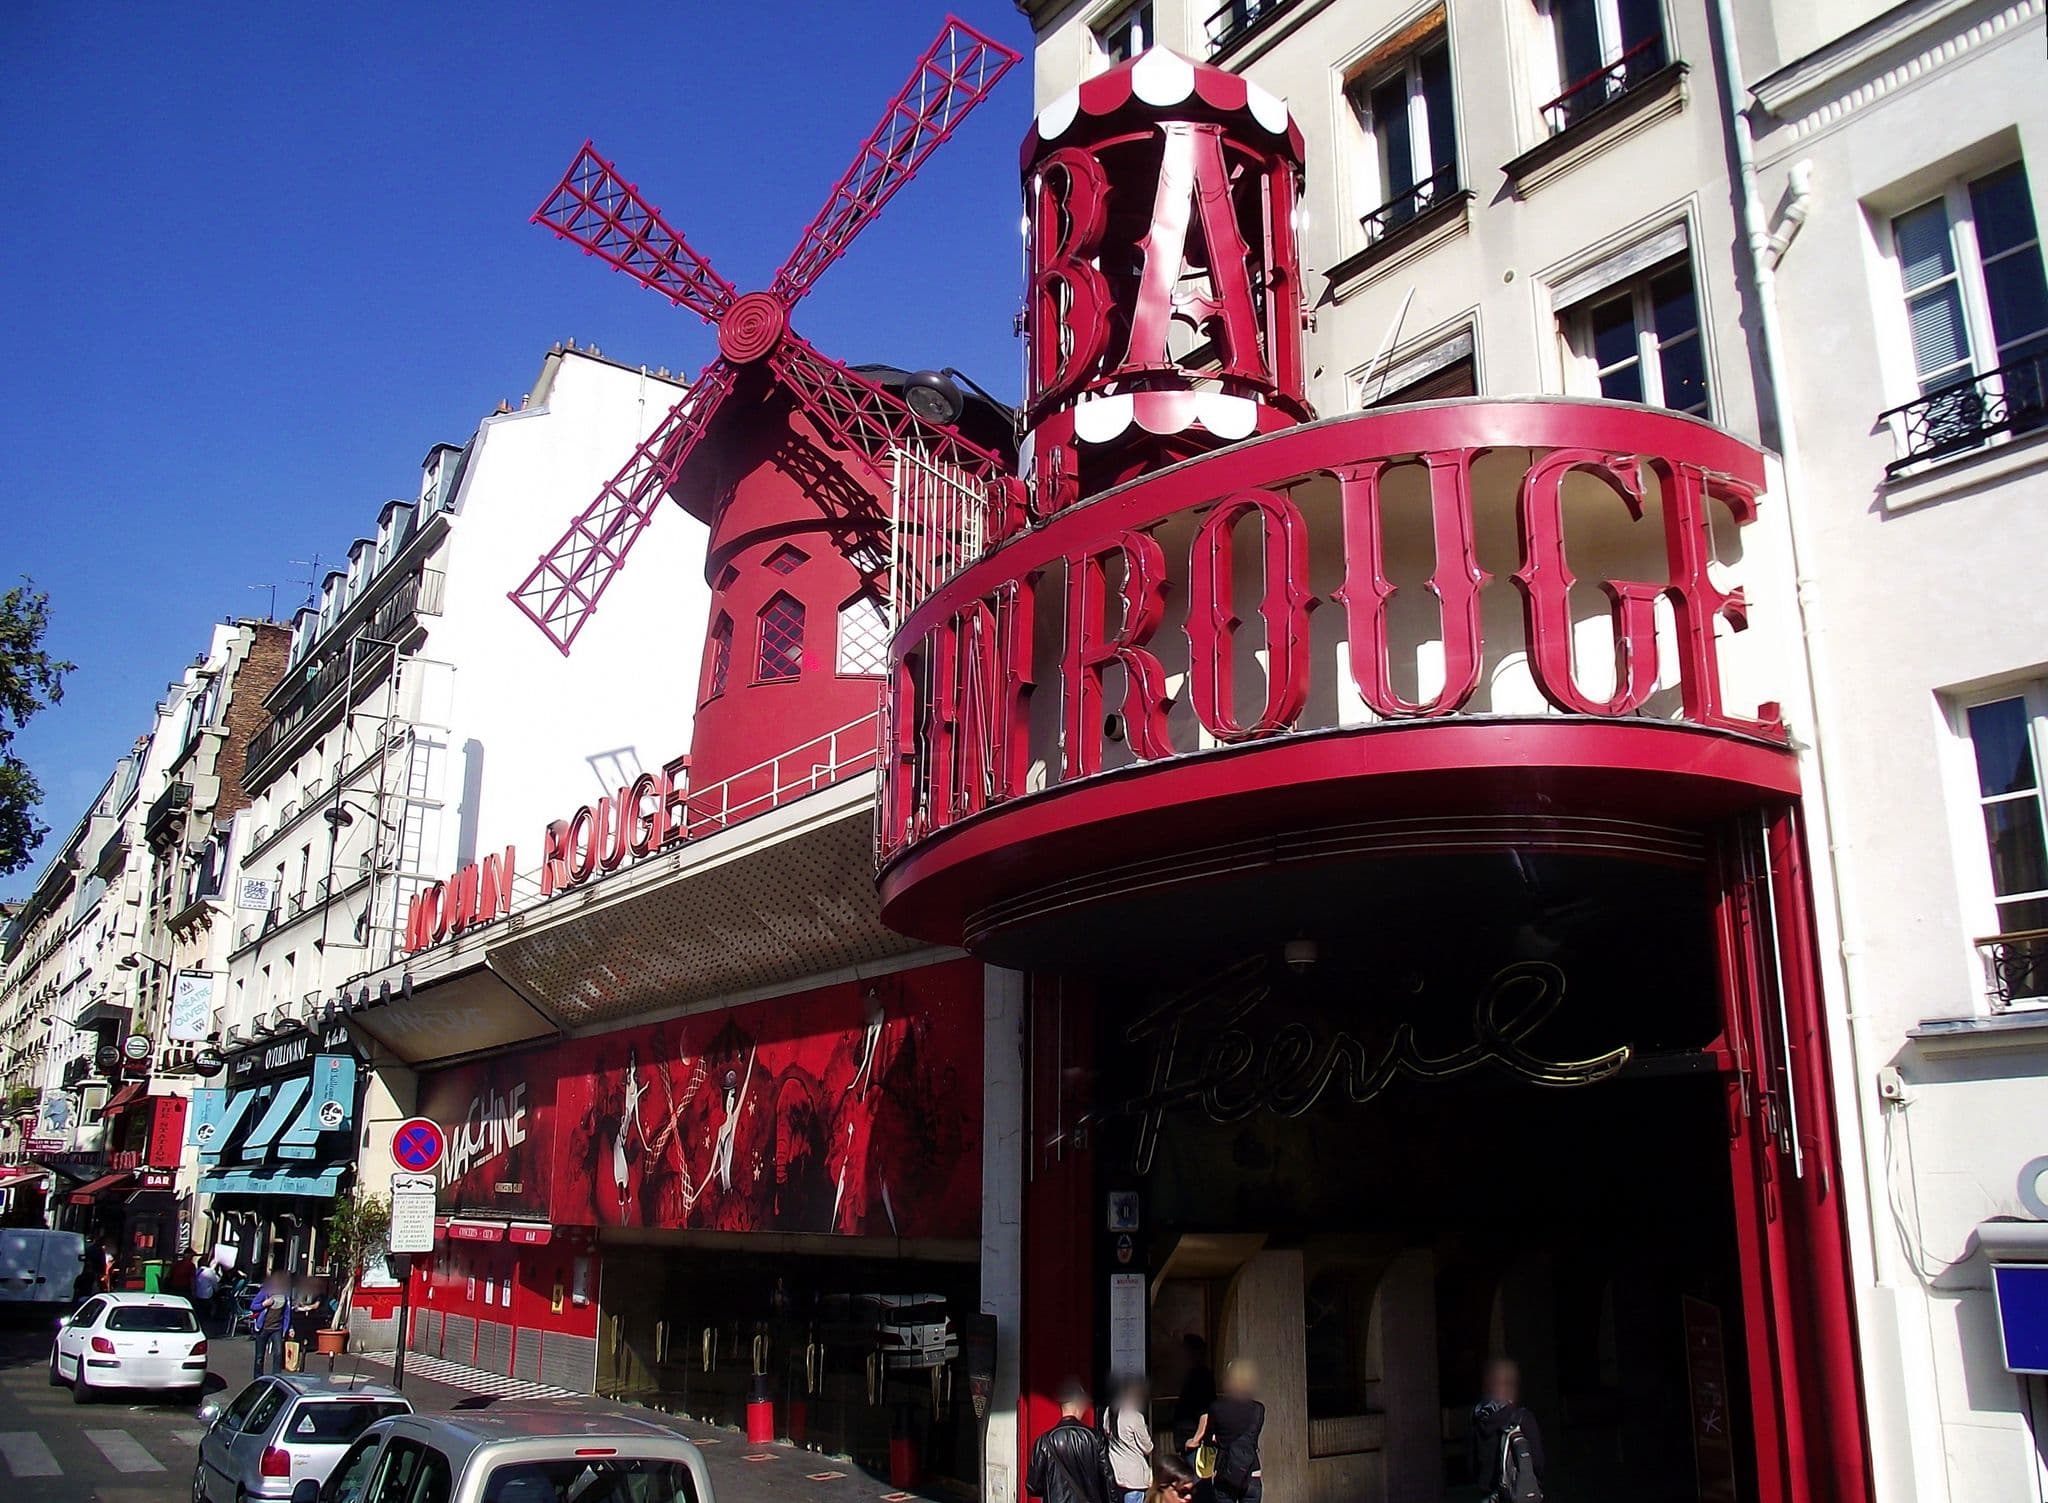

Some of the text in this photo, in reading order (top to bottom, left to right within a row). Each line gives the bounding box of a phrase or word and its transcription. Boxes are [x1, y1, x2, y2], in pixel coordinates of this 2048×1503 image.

[1057, 446, 1788, 781] ROUGE
[541, 754, 692, 896] ROUGE
[147, 1175, 170, 1185] BAR
[441, 1082, 526, 1190] MACHINE
